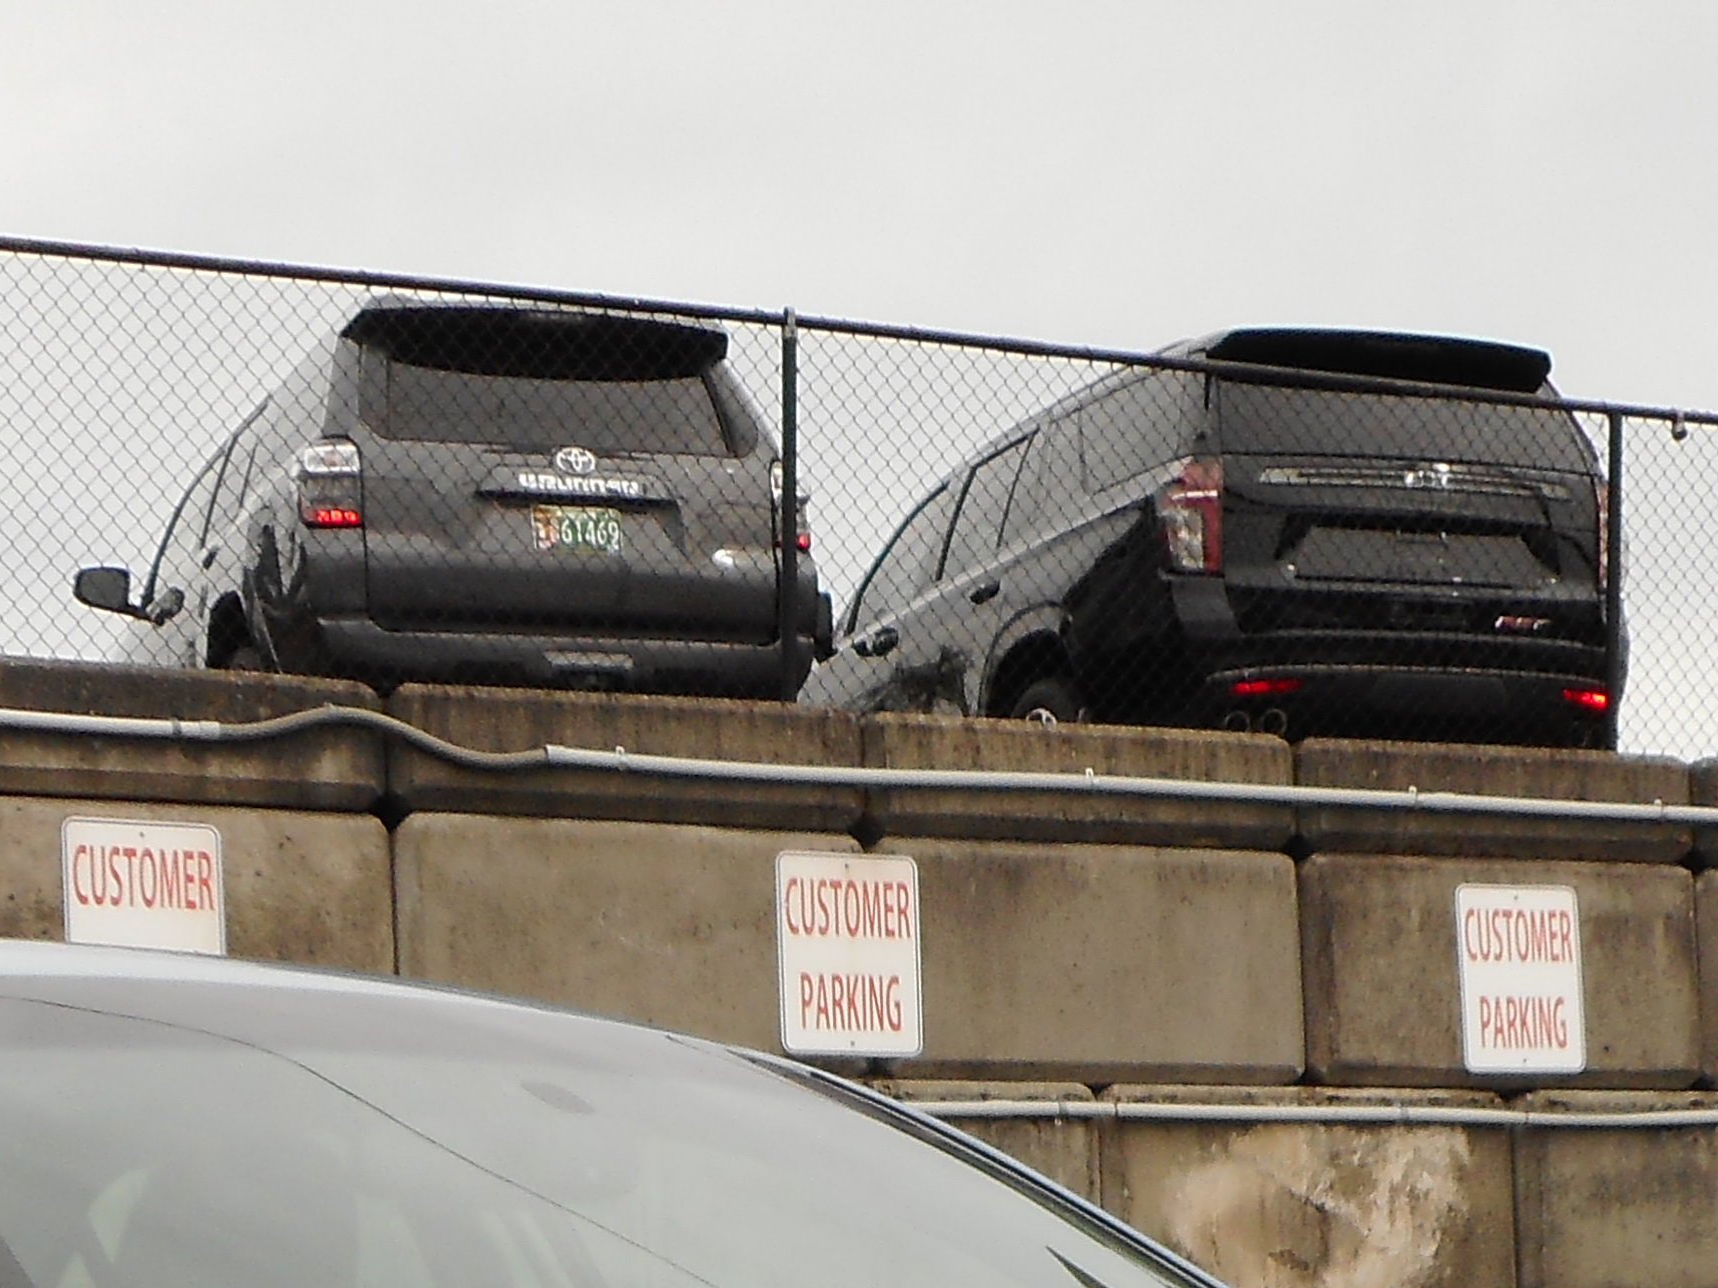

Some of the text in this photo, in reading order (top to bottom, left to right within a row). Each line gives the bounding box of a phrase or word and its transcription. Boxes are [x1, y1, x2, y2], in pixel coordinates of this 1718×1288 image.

[73, 844, 215, 911] CUSTOMER
[785, 877, 911, 938] CUSTOMER
[1465, 907, 1573, 963] CUSTOMER
[799, 971, 902, 1032] PARKING
[1479, 995, 1568, 1049] PARKING
